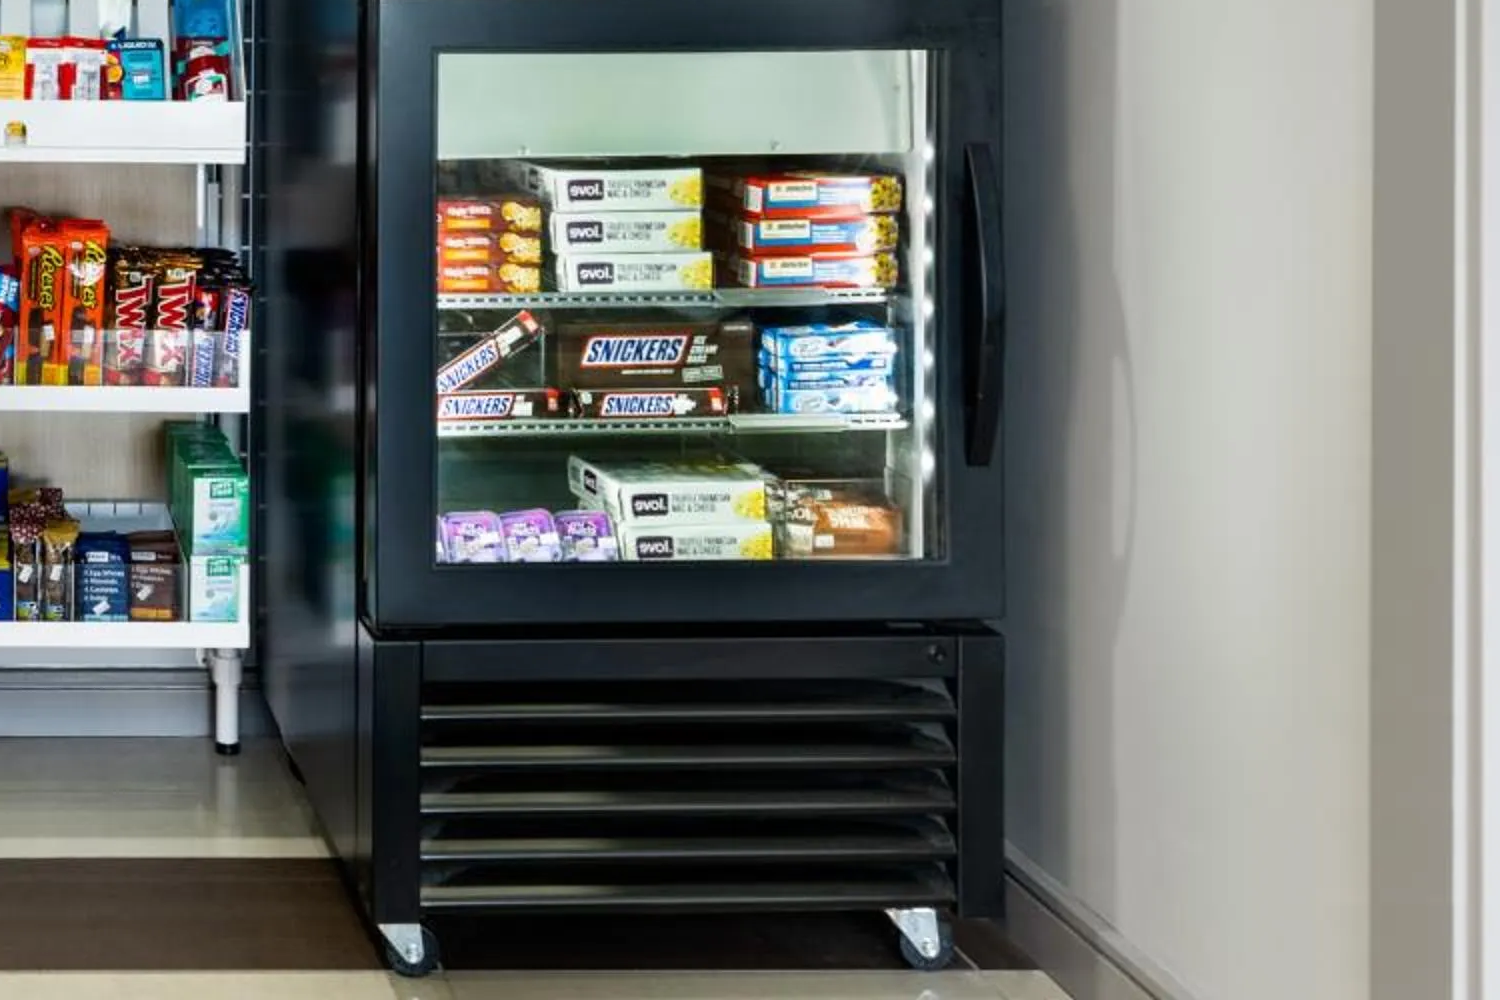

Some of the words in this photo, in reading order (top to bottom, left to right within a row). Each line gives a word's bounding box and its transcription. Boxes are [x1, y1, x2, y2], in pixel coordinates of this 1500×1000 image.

[587, 338, 684, 363] SNICKERS
[443, 397, 510, 416] SNICKERS
[604, 395, 672, 414] SNICKERS
